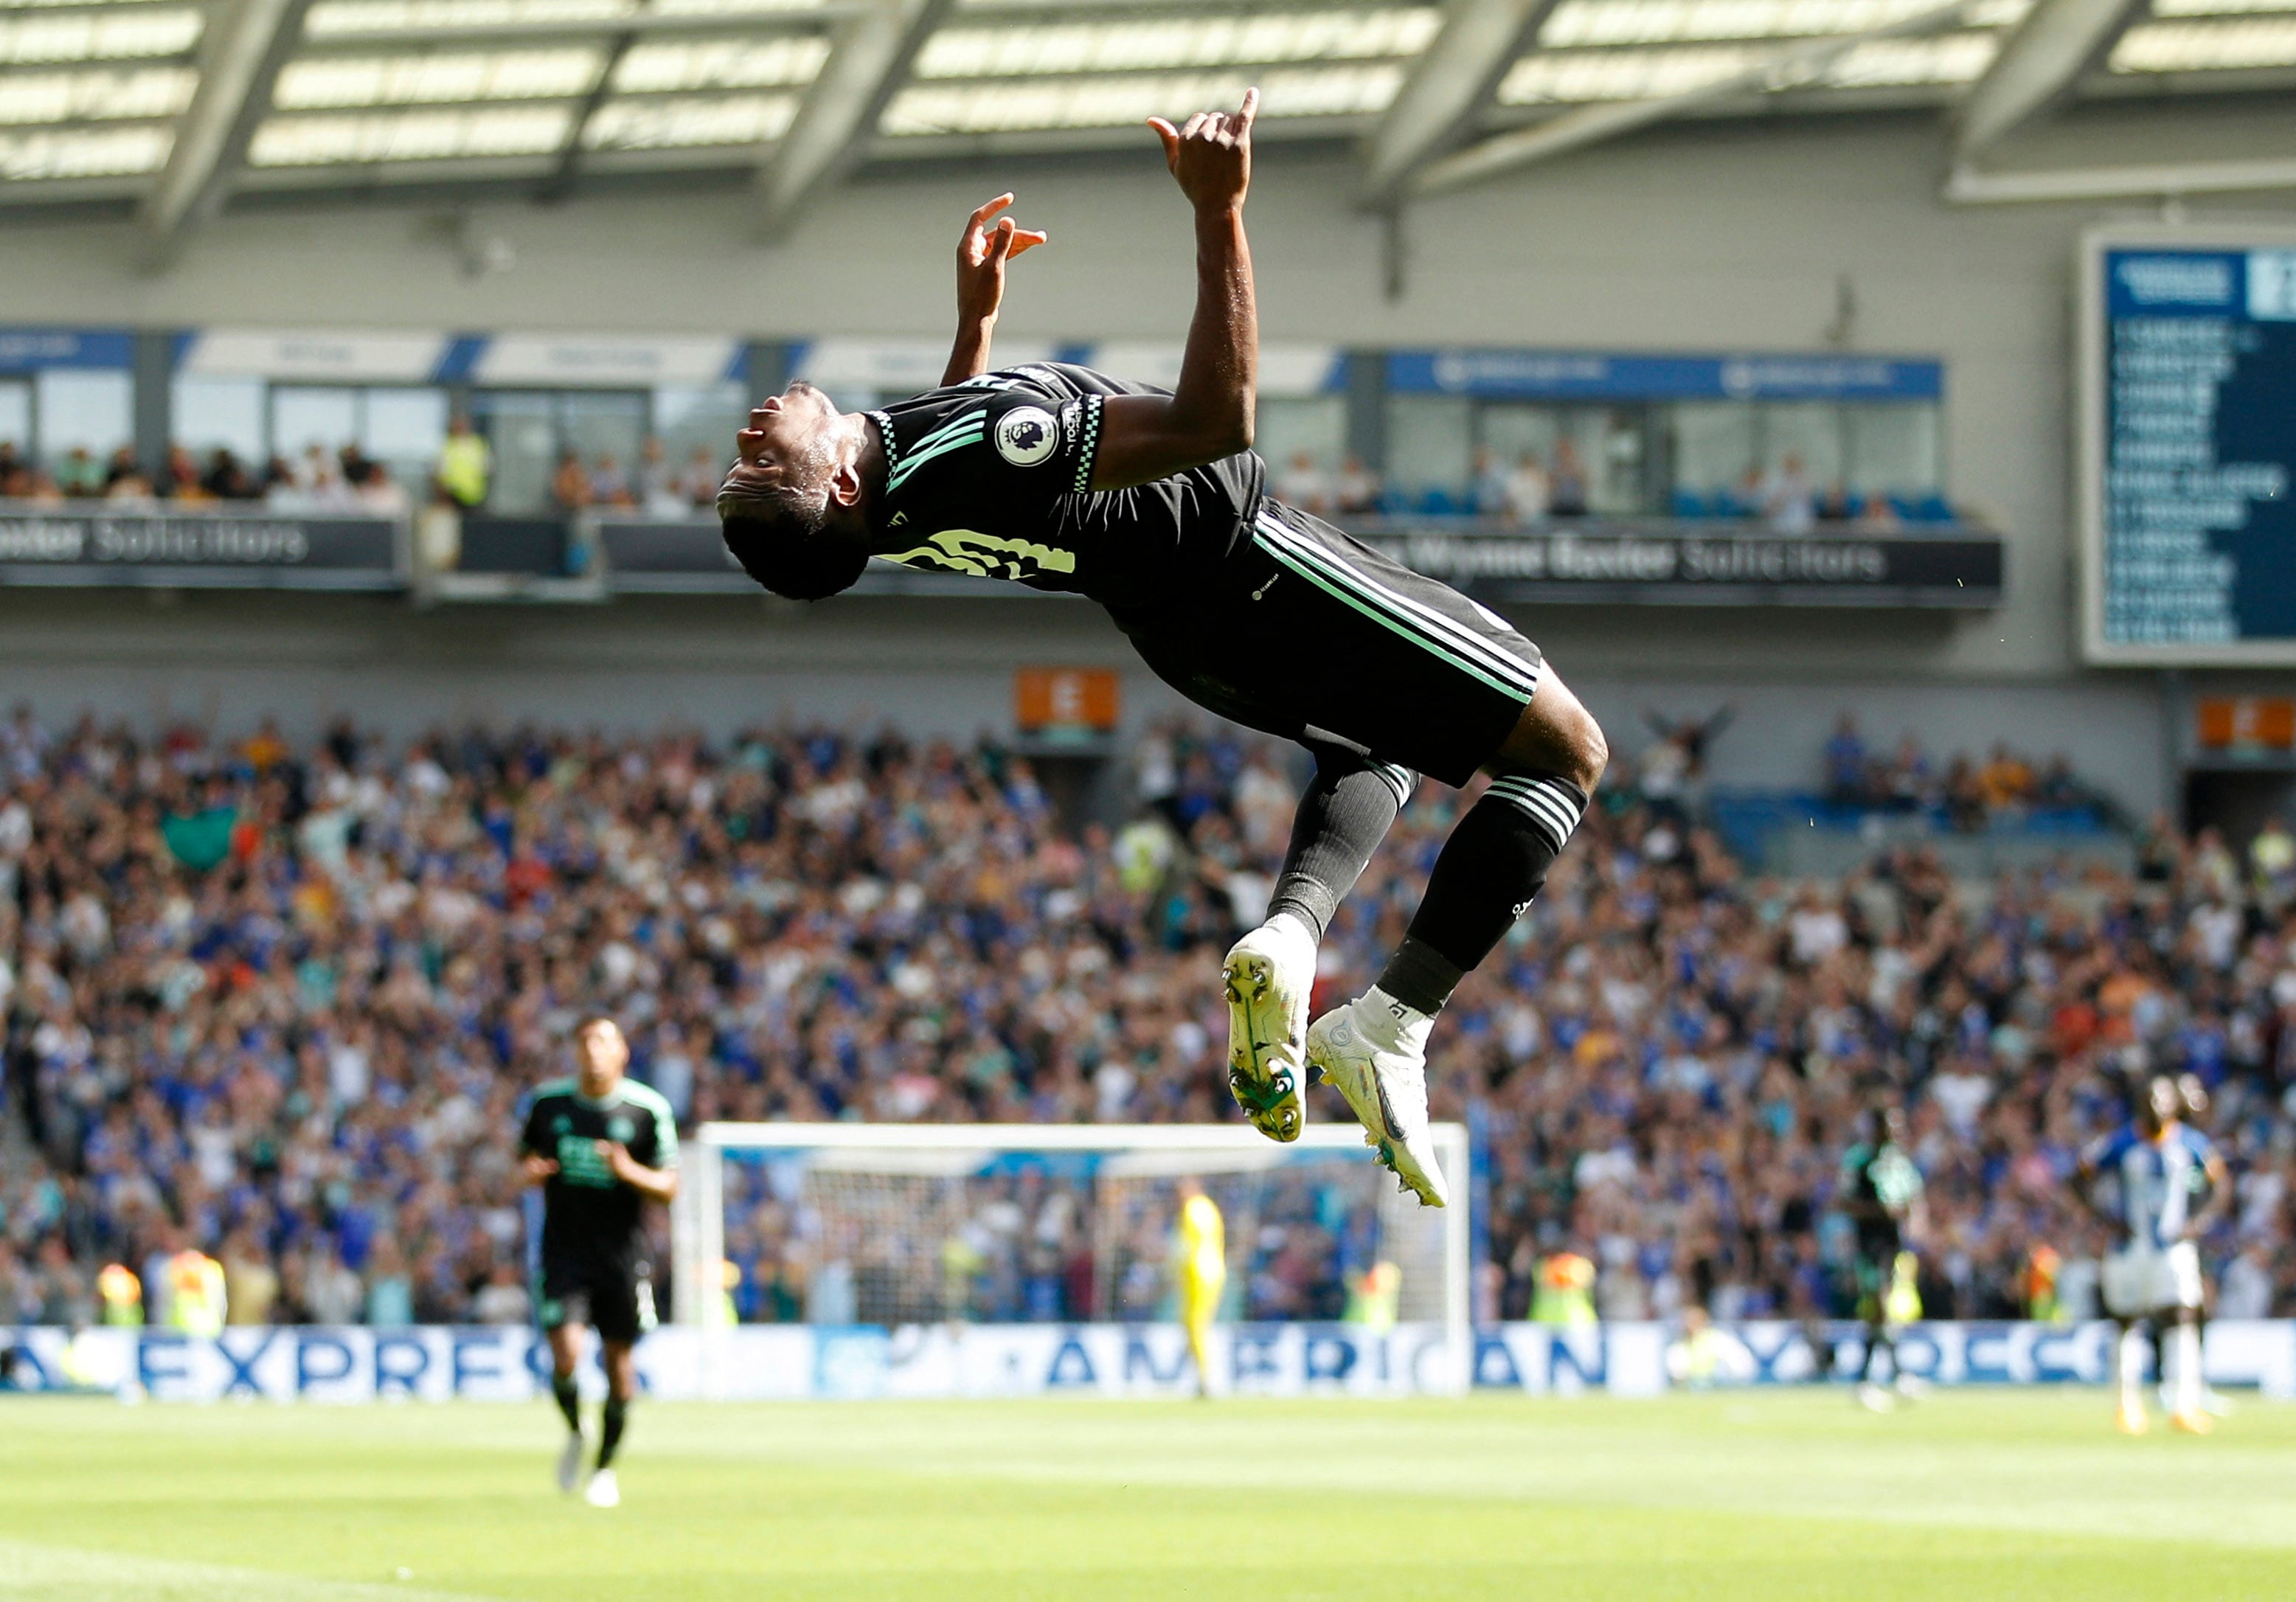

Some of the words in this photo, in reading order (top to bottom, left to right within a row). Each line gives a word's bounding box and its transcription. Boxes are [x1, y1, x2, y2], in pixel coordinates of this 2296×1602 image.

[91, 519, 311, 564] Solicitors
[1681, 536, 1887, 583] Solicitors
[138, 1328, 651, 1393] EXPRE
